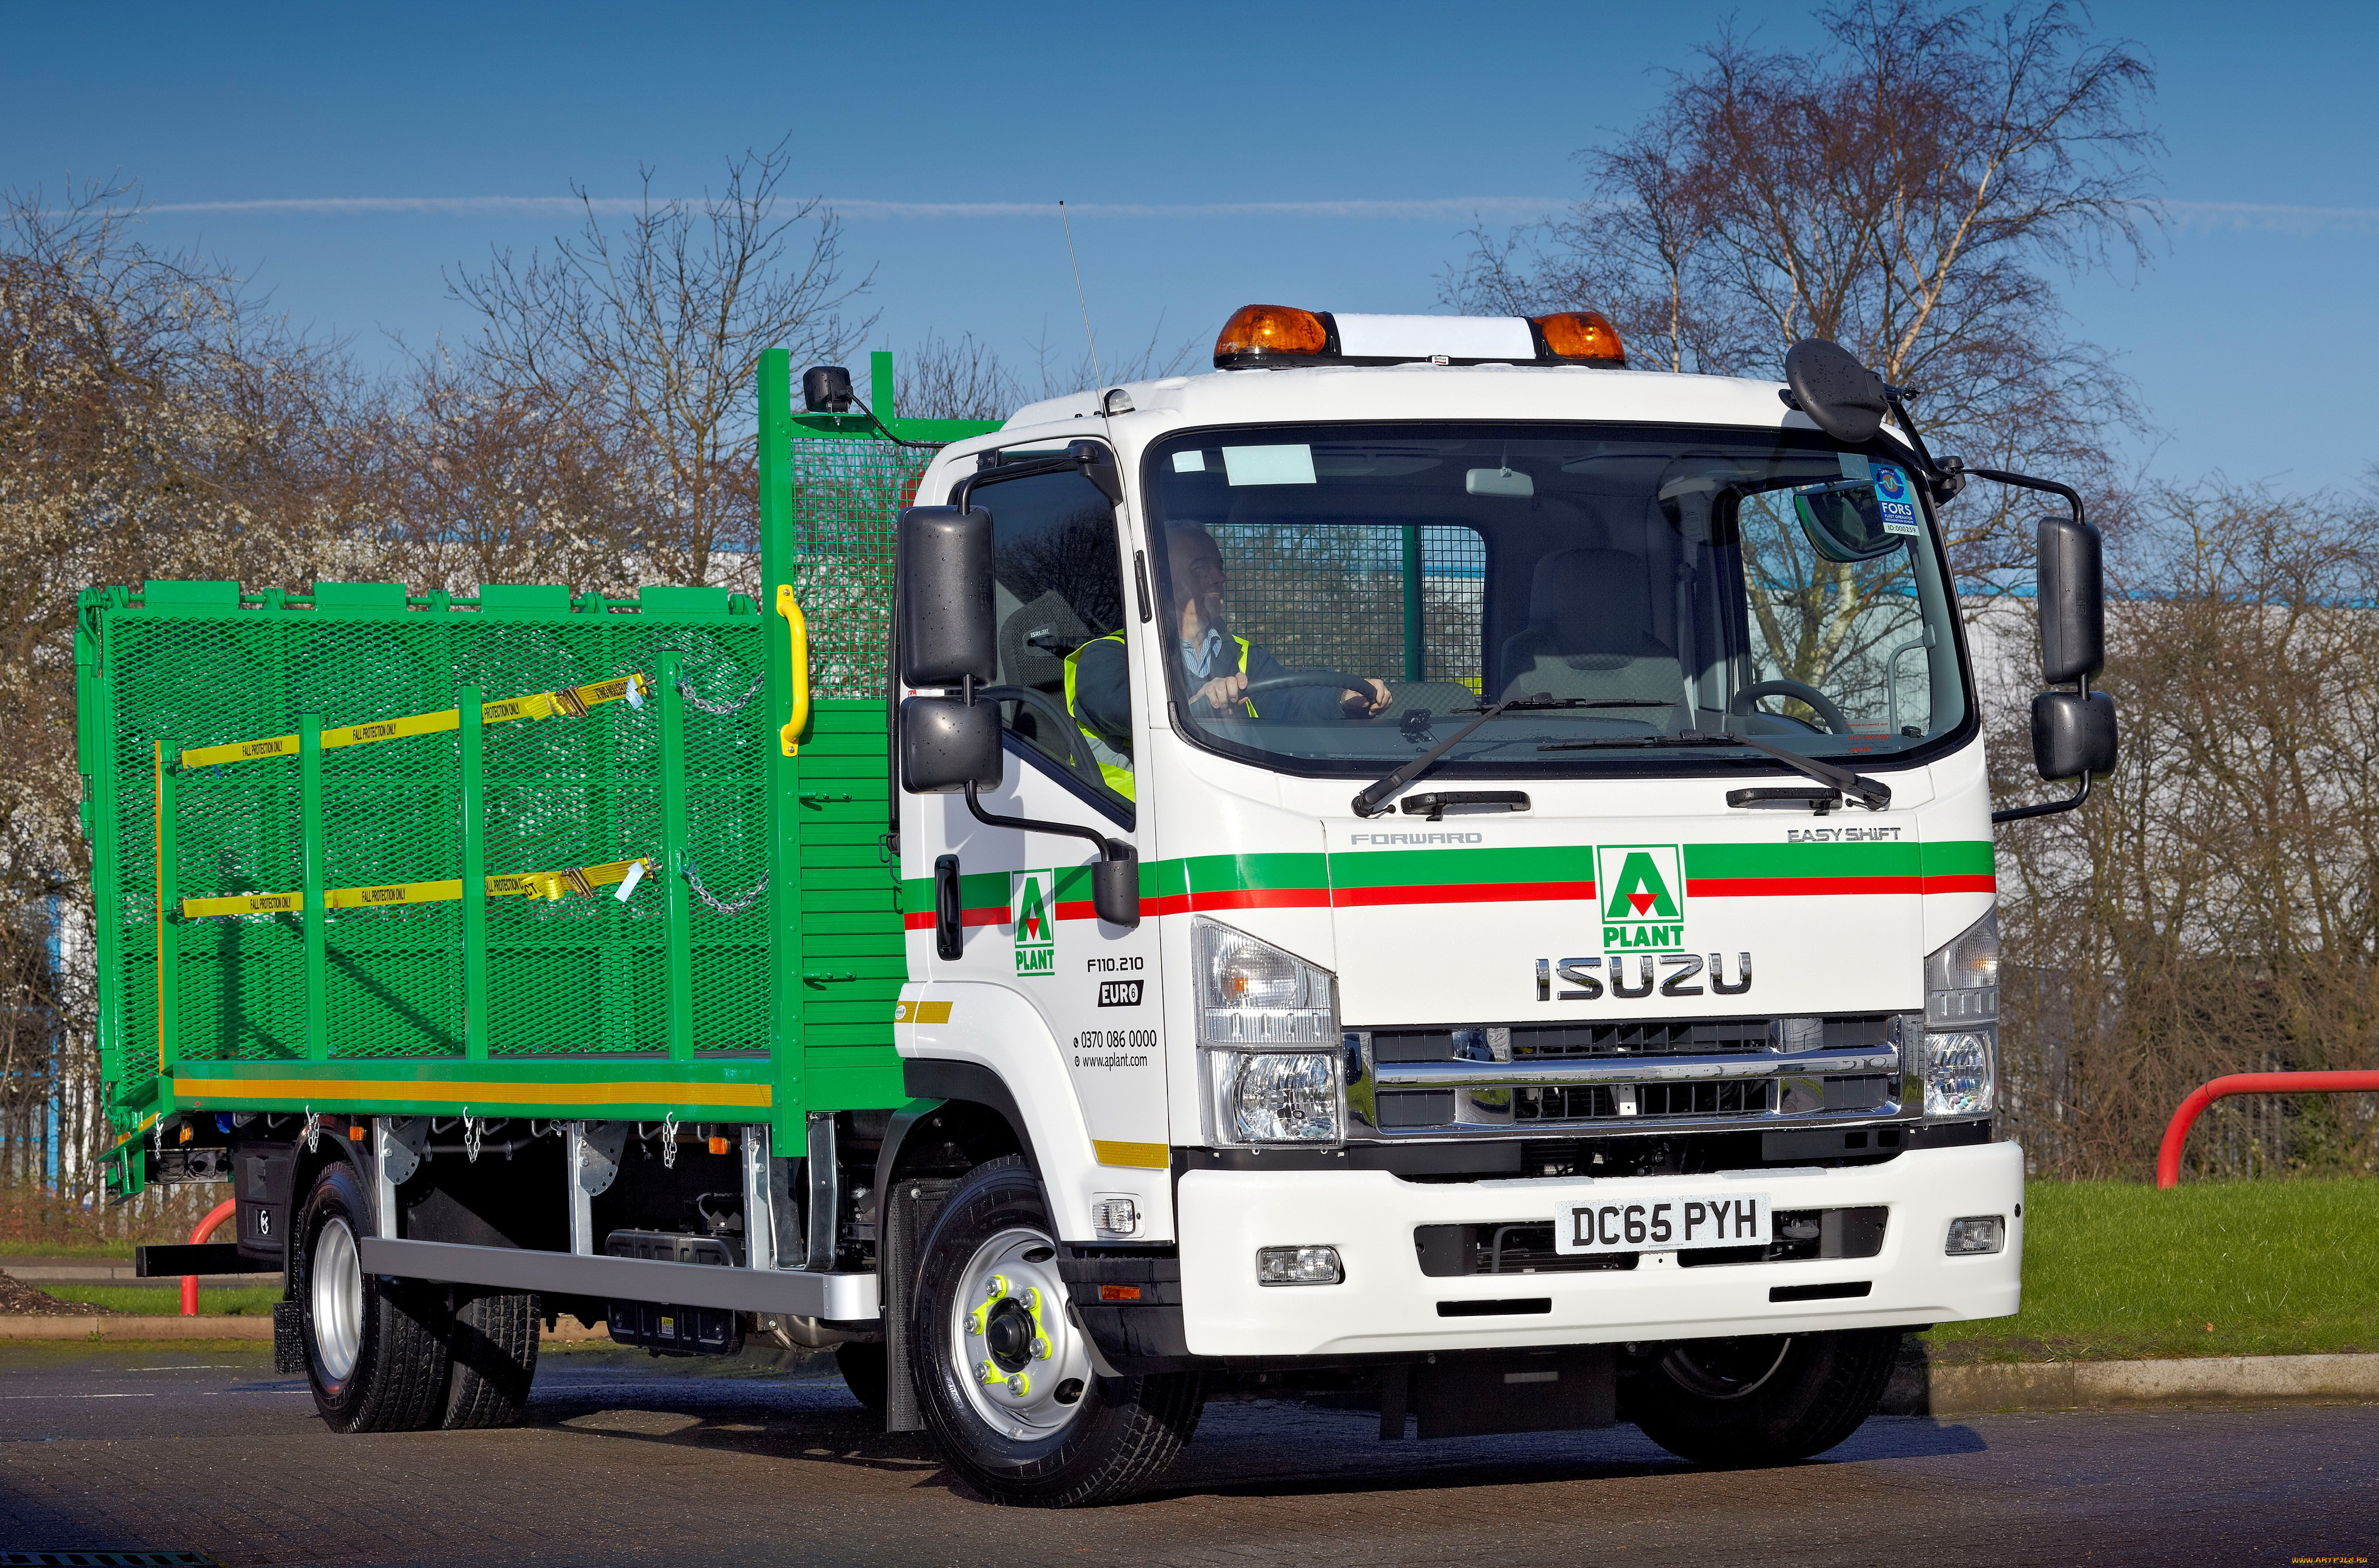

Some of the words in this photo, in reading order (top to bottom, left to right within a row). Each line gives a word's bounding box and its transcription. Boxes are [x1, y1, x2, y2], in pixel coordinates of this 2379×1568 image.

[1882, 502, 1911, 516] FORS
[484, 704, 509, 720] PROTECTION
[508, 702, 520, 715] ONLY
[353, 728, 362, 741] FALL
[363, 725, 386, 739] PROTECTION
[386, 722, 397, 736] ONLY
[242, 745, 251, 757] FALL
[251, 742, 274, 756] PROTECTION
[274, 740, 283, 752] ONLY
[1351, 833, 1482, 845] FORWARD
[1787, 828, 1842, 843] EASY
[1845, 828, 1901, 841] SHIFT
[493, 877, 519, 892] PROTECTION
[1606, 852, 1680, 918] A
[250, 898, 259, 910] FALL
[260, 897, 282, 909] PROTECTION
[282, 897, 291, 908] ONLY
[362, 890, 371, 902] FALL
[372, 889, 395, 902] PROTECTION
[396, 887, 405, 900] ONLY
[1016, 877, 1051, 942] A
[1603, 926, 1684, 947] PLANT
[1015, 949, 1054, 970] PLANT
[1087, 956, 1144, 973] F110.210
[1535, 952, 1752, 1001] ISUZU
[1081, 1031, 1103, 1048] 0370
[1106, 1030, 1126, 1048] 086
[1129, 1029, 1157, 1047] 0000
[1083, 1052, 1148, 1071] www.aplant.com
[1572, 1203, 1672, 1246] DC65
[1685, 1199, 1756, 1241] PYH
